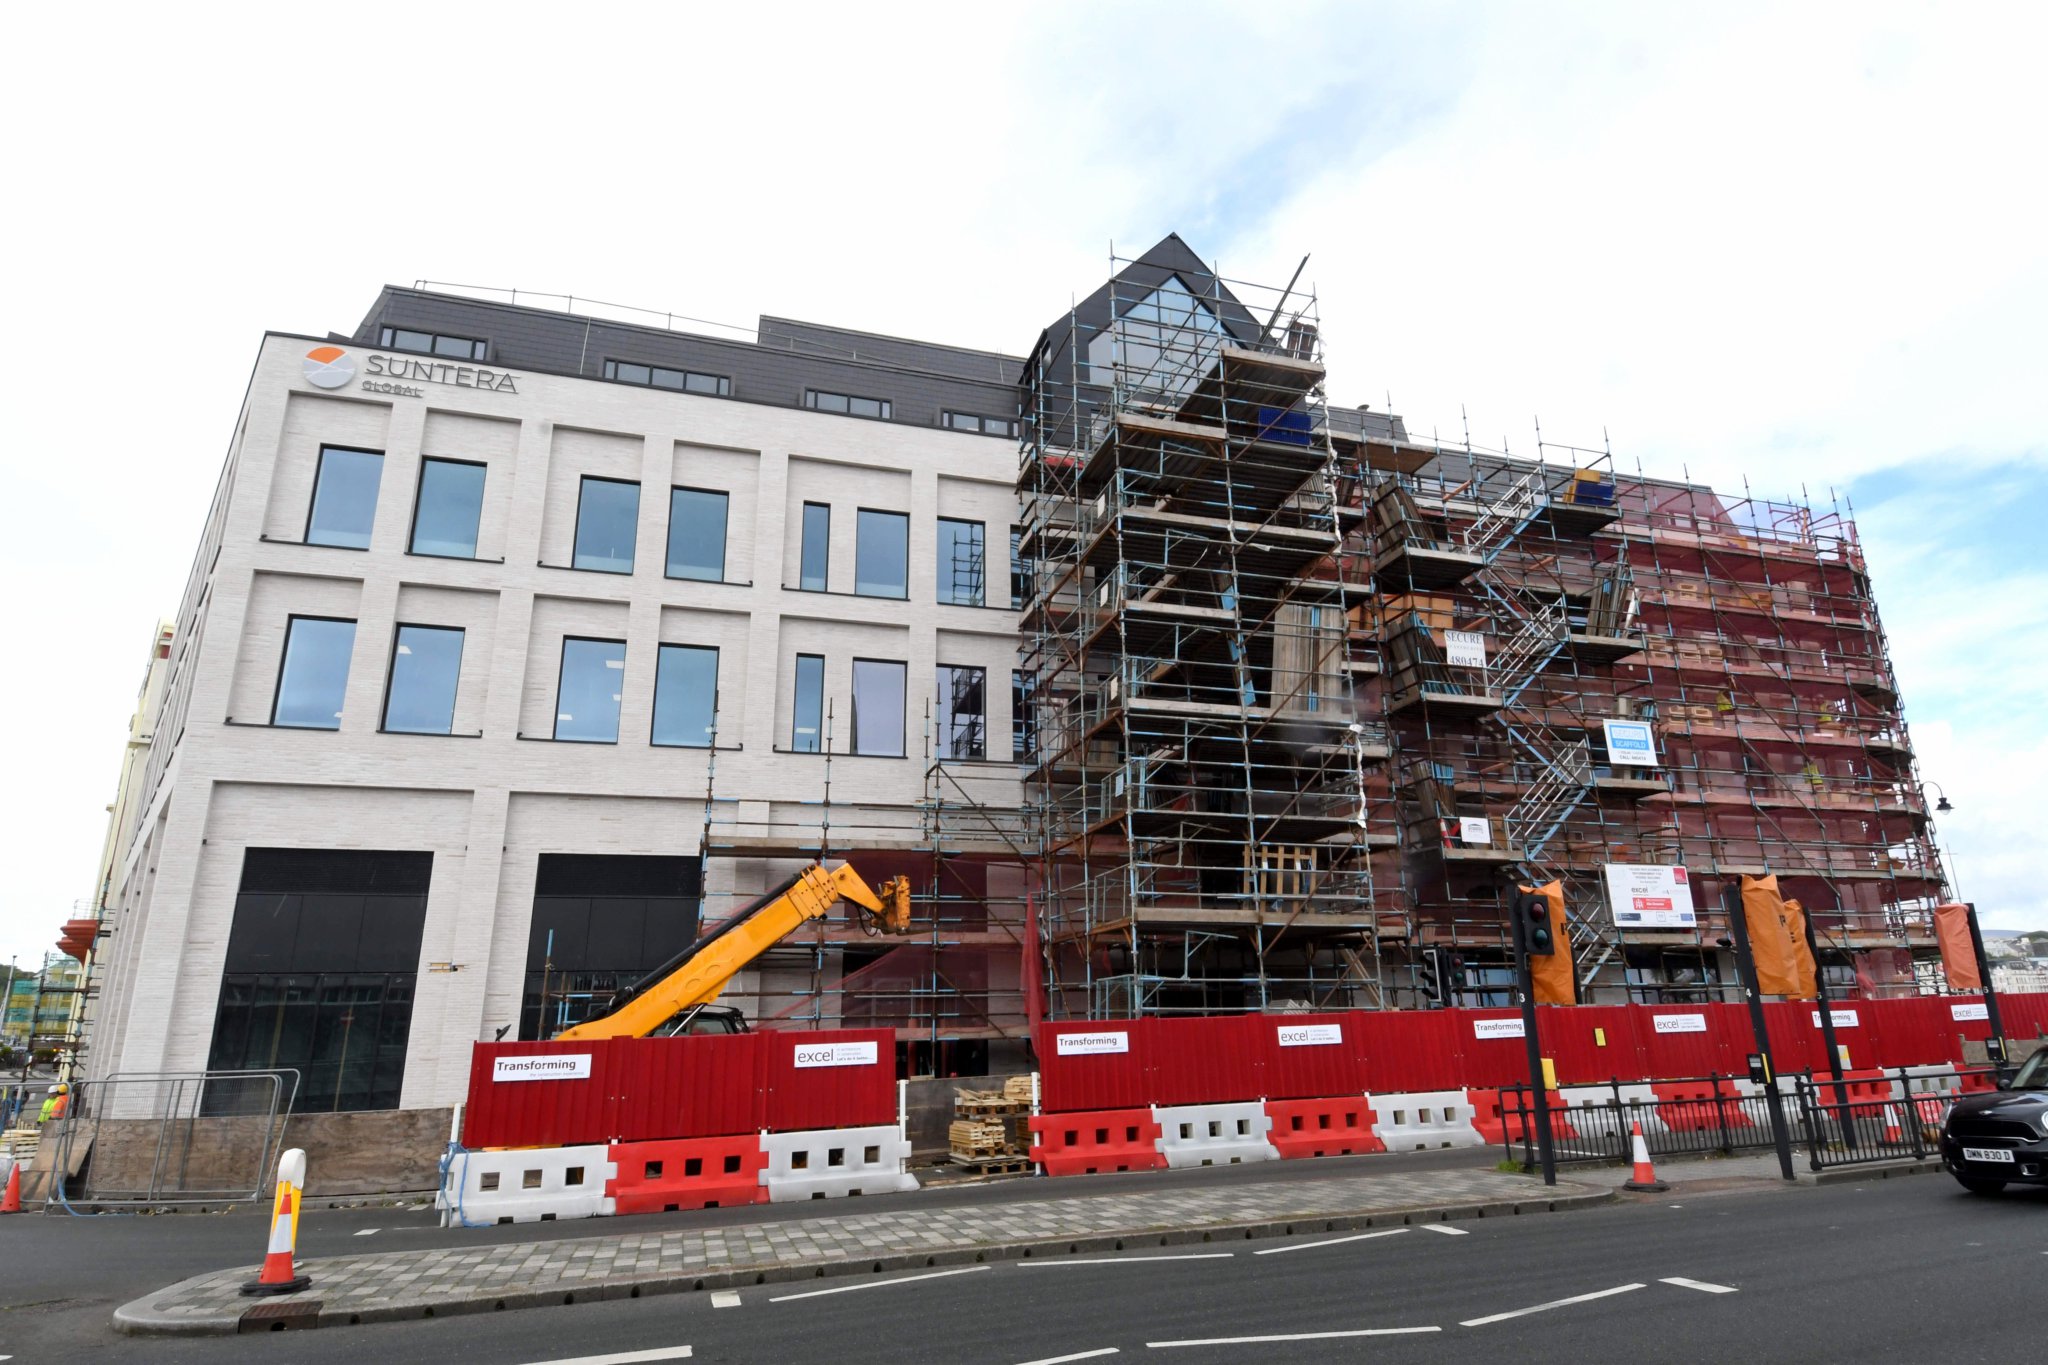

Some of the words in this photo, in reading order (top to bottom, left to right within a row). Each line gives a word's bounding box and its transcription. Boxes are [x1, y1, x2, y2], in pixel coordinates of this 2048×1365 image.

[366, 354, 519, 394] SUNTERA
[362, 380, 423, 398] GLOBAL
[1446, 631, 1482, 644] SECURE
[1450, 655, 1484, 667] 480474
[1615, 740, 1646, 749] SCAFFOLD
[1519, 992, 1526, 1003] 3
[1745, 987, 1752, 997] 4
[1814, 1013, 1851, 1021] Trorming
[1954, 1008, 1972, 1017] excel
[1476, 1022, 1522, 1031] Transforming
[1657, 1018, 1679, 1029] excel
[1059, 1036, 1117, 1046] Transforming
[1281, 1030, 1308, 1042] excel
[798, 1048, 833, 1062] excel
[497, 1060, 576, 1071] Transforming
[1966, 1149, 1983, 1159] DMN
[1984, 1151, 2002, 1160] 830
[2003, 1151, 2011, 1160] D
